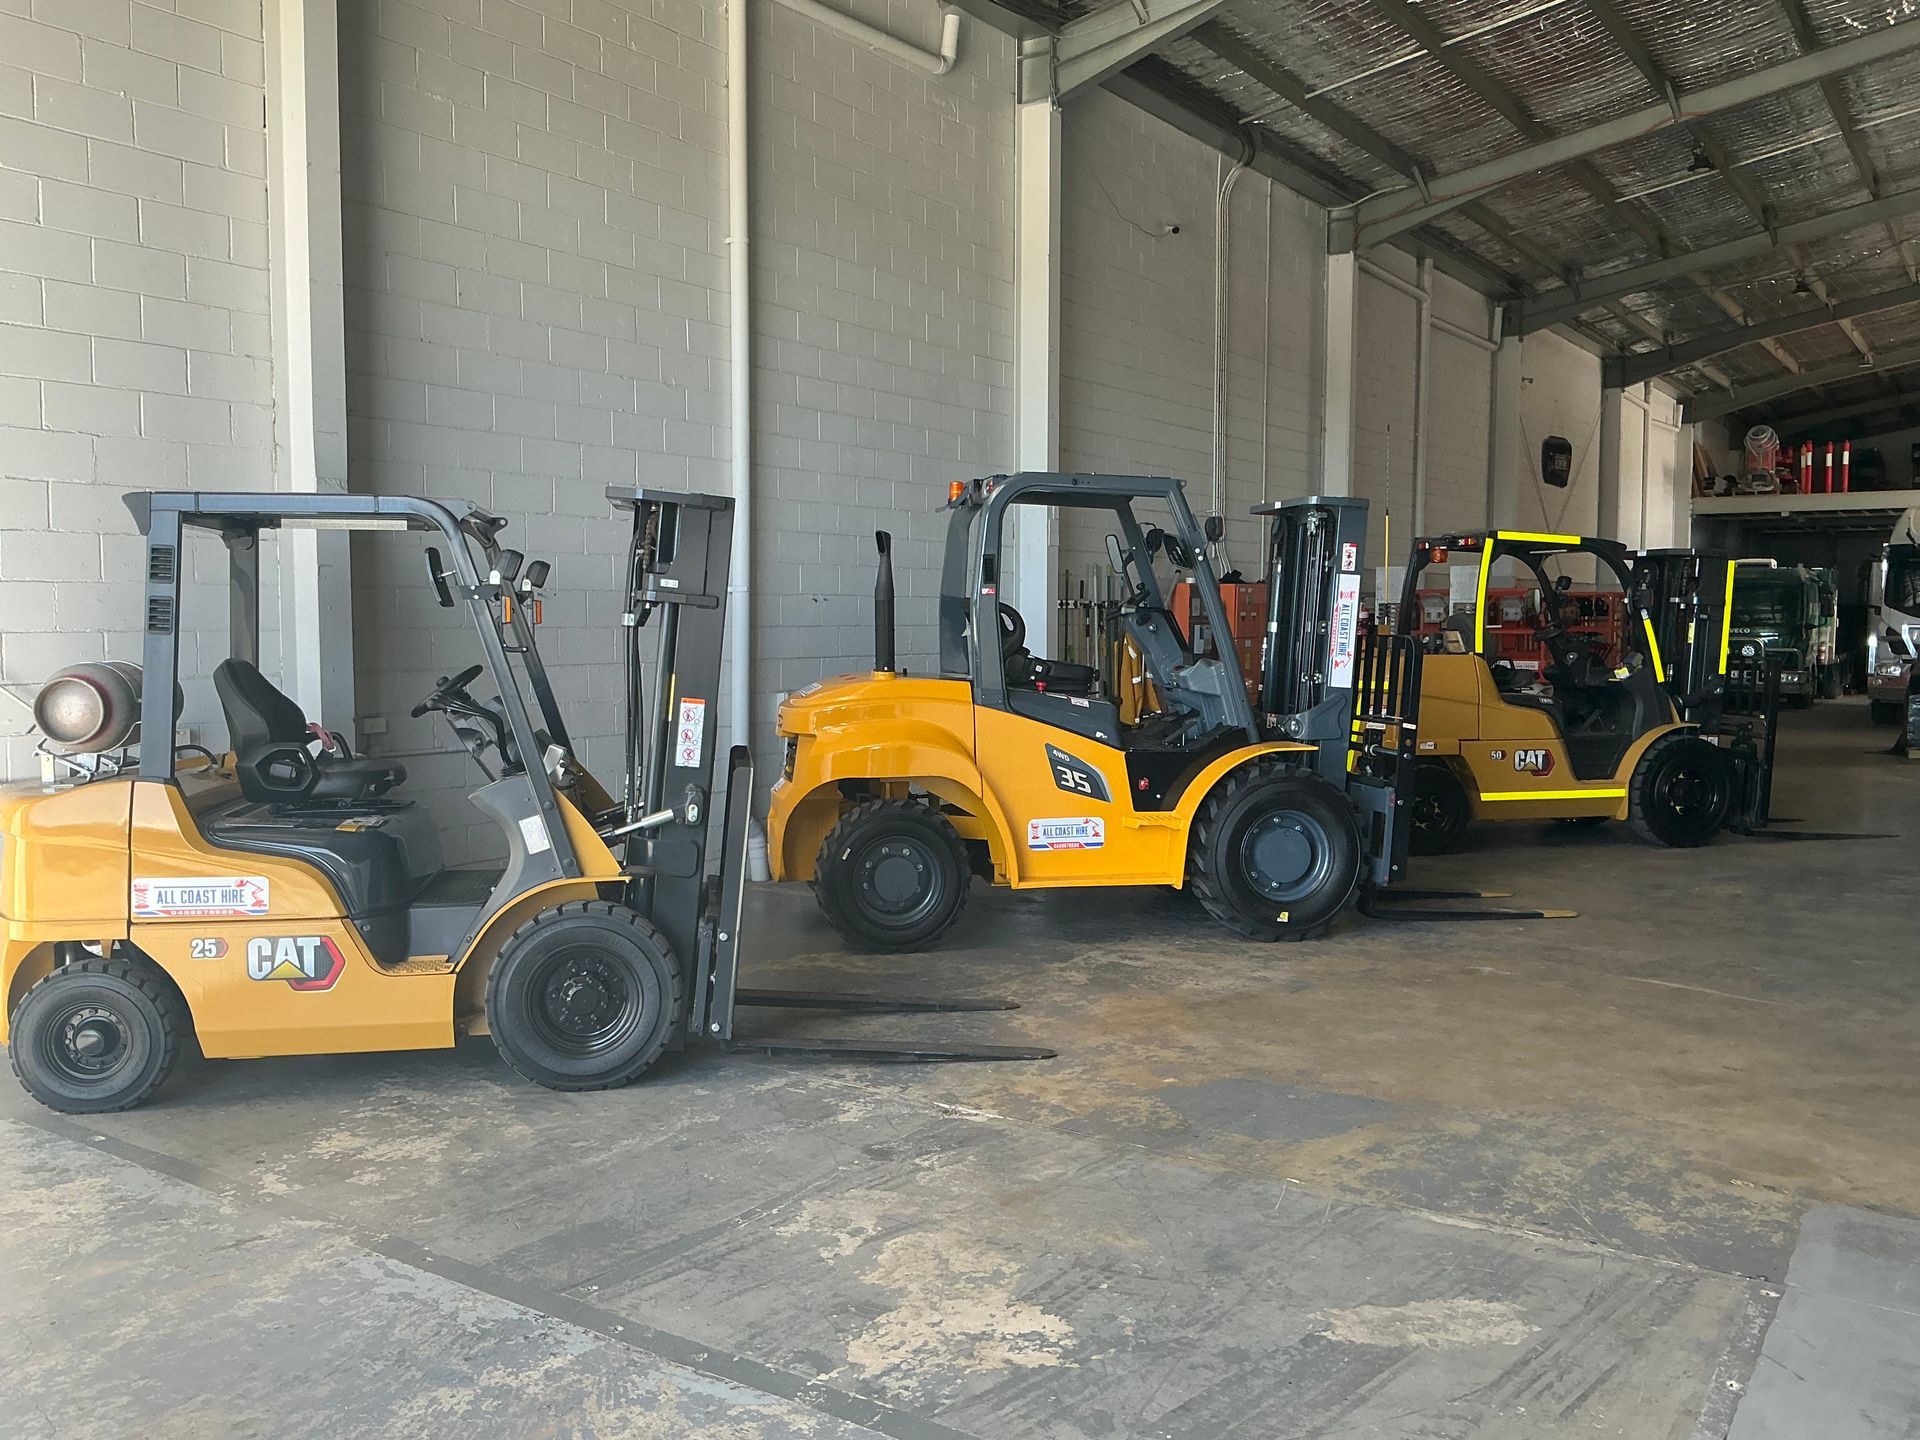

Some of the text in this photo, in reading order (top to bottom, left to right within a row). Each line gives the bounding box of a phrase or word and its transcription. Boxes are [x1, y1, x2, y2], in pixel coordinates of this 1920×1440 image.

[1338, 603, 1350, 657] ALL COAST HIRE
[1052, 749, 1070, 762] 4WD
[1490, 751, 1502, 760] 50
[1514, 750, 1546, 770] CAT
[1056, 765, 1092, 793] 35
[1042, 825, 1089, 837] ALL COAST HIRE
[156, 888, 245, 905] ALL COAST HIRE
[190, 938, 218, 958] 25
[248, 936, 321, 979] CAT
